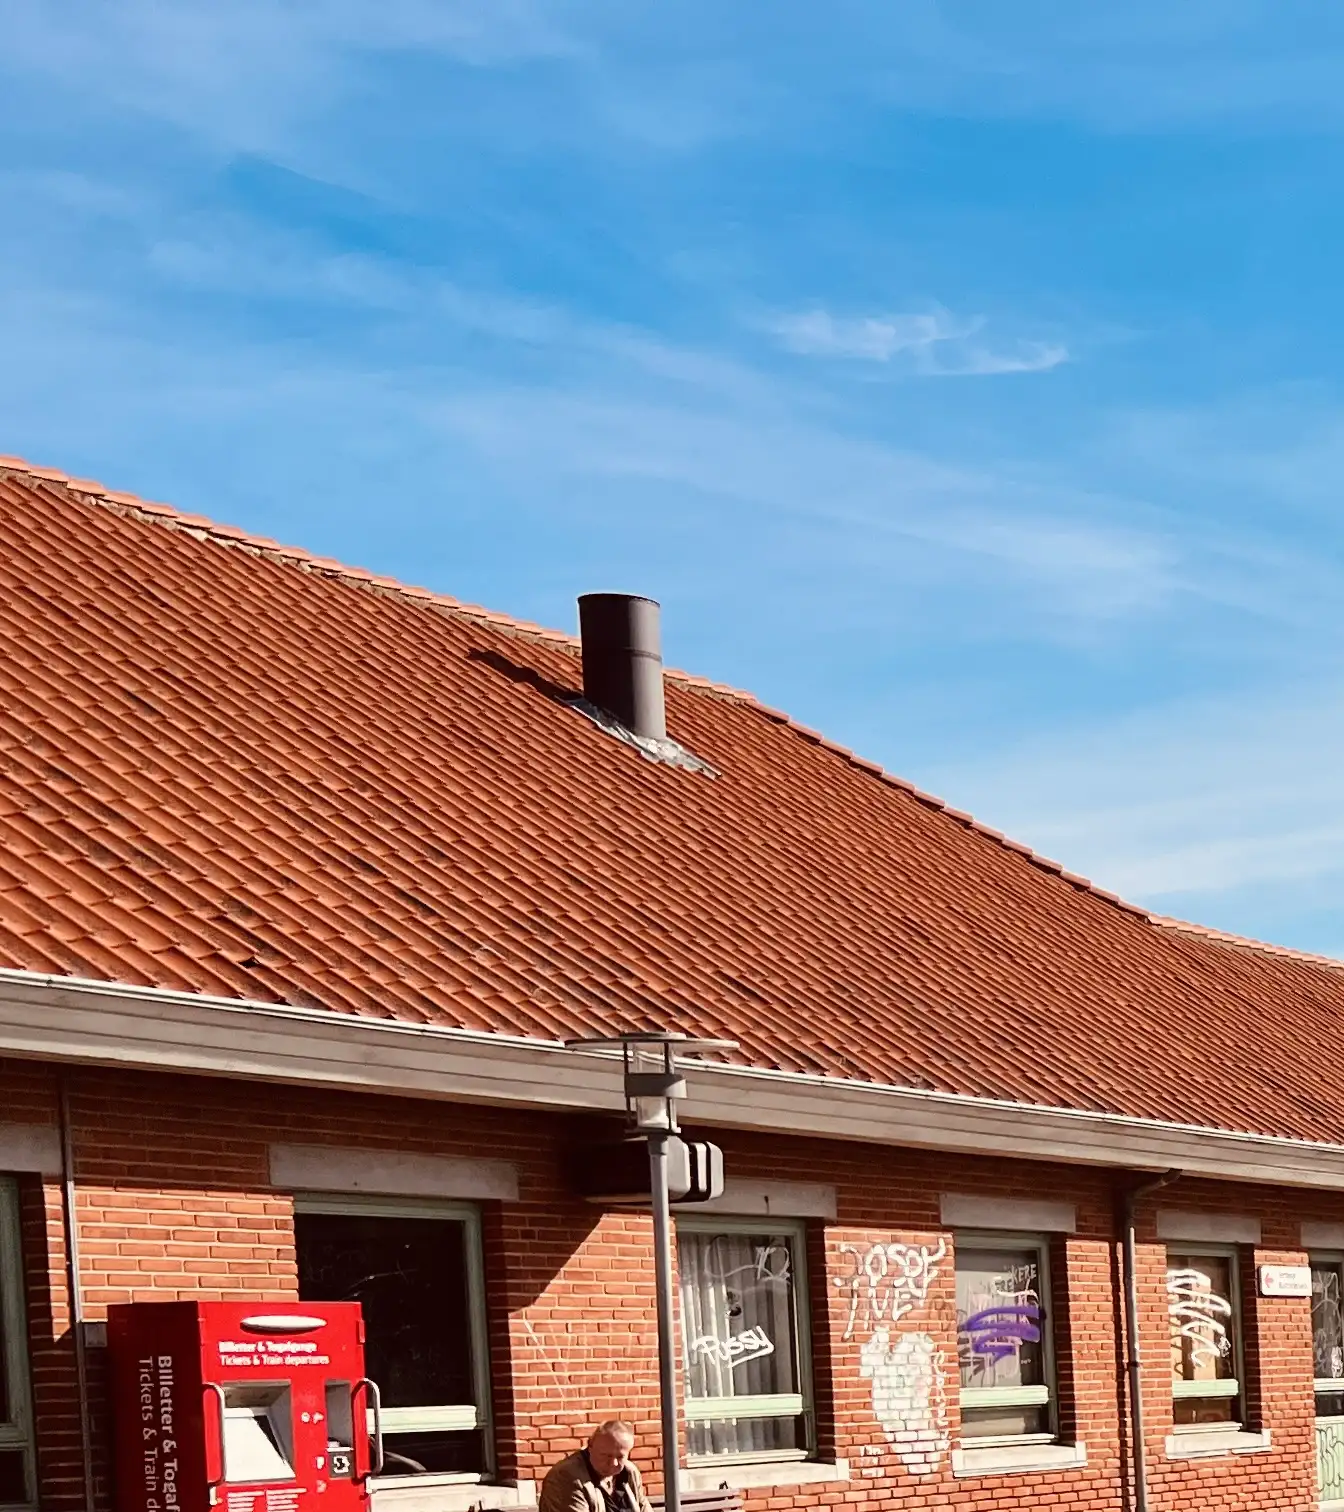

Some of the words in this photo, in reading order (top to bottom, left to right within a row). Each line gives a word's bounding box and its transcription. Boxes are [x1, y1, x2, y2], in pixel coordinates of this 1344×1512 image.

[139, 1356, 154, 1421] Tickets
[157, 1355, 173, 1434] Billetter
[142, 1427, 157, 1441] &
[162, 1439, 178, 1453] &
[144, 1447, 160, 1492] Train
